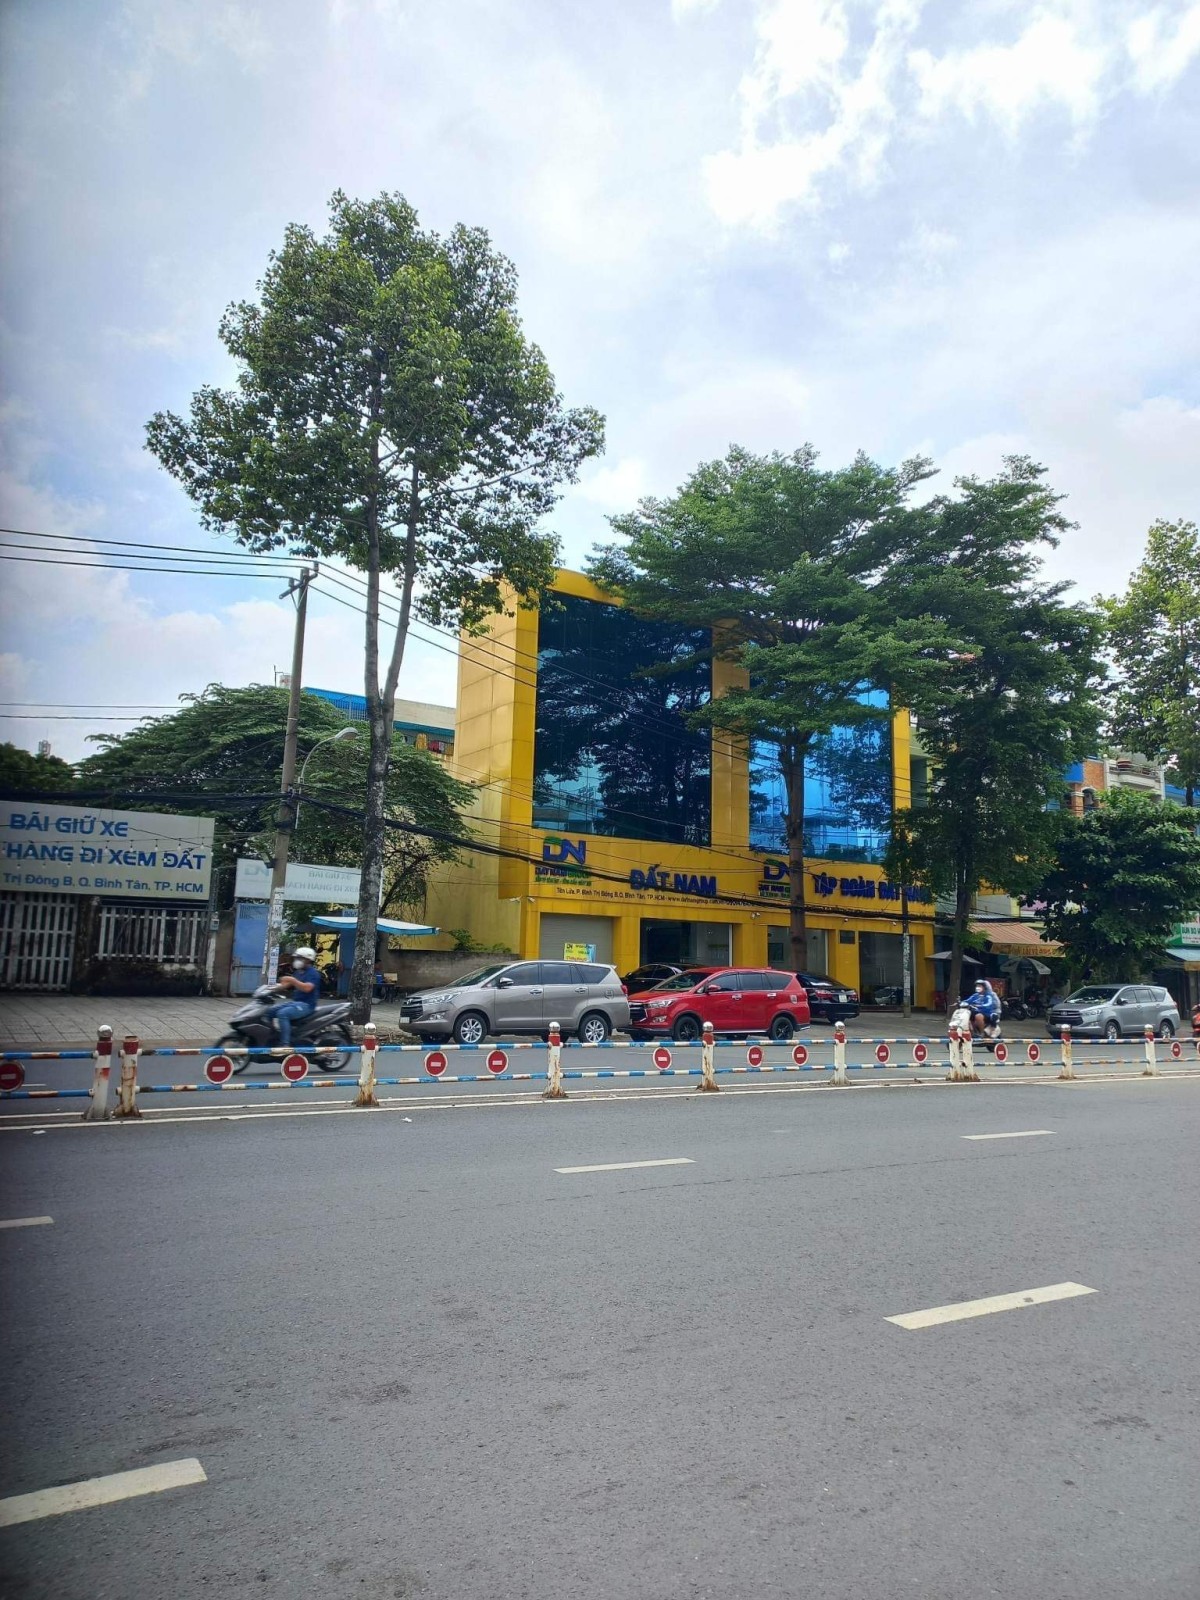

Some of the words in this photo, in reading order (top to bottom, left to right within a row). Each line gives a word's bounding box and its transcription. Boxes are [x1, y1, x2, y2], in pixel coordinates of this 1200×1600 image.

[9, 811, 49, 832] BÃI
[55, 815, 97, 834] GIỮ
[100, 820, 129, 837] XE
[6, 840, 74, 862] HÀNG
[79, 846, 103, 864] ĐI
[108, 848, 157, 867] XEM
[162, 847, 207, 870] ĐẤT
[543, 836, 587, 865] DN
[25, 874, 60, 888] Đông
[176, 882, 204, 894] HCM
[630, 864, 671, 891] ĐẤT
[673, 873, 717, 897] NAM
